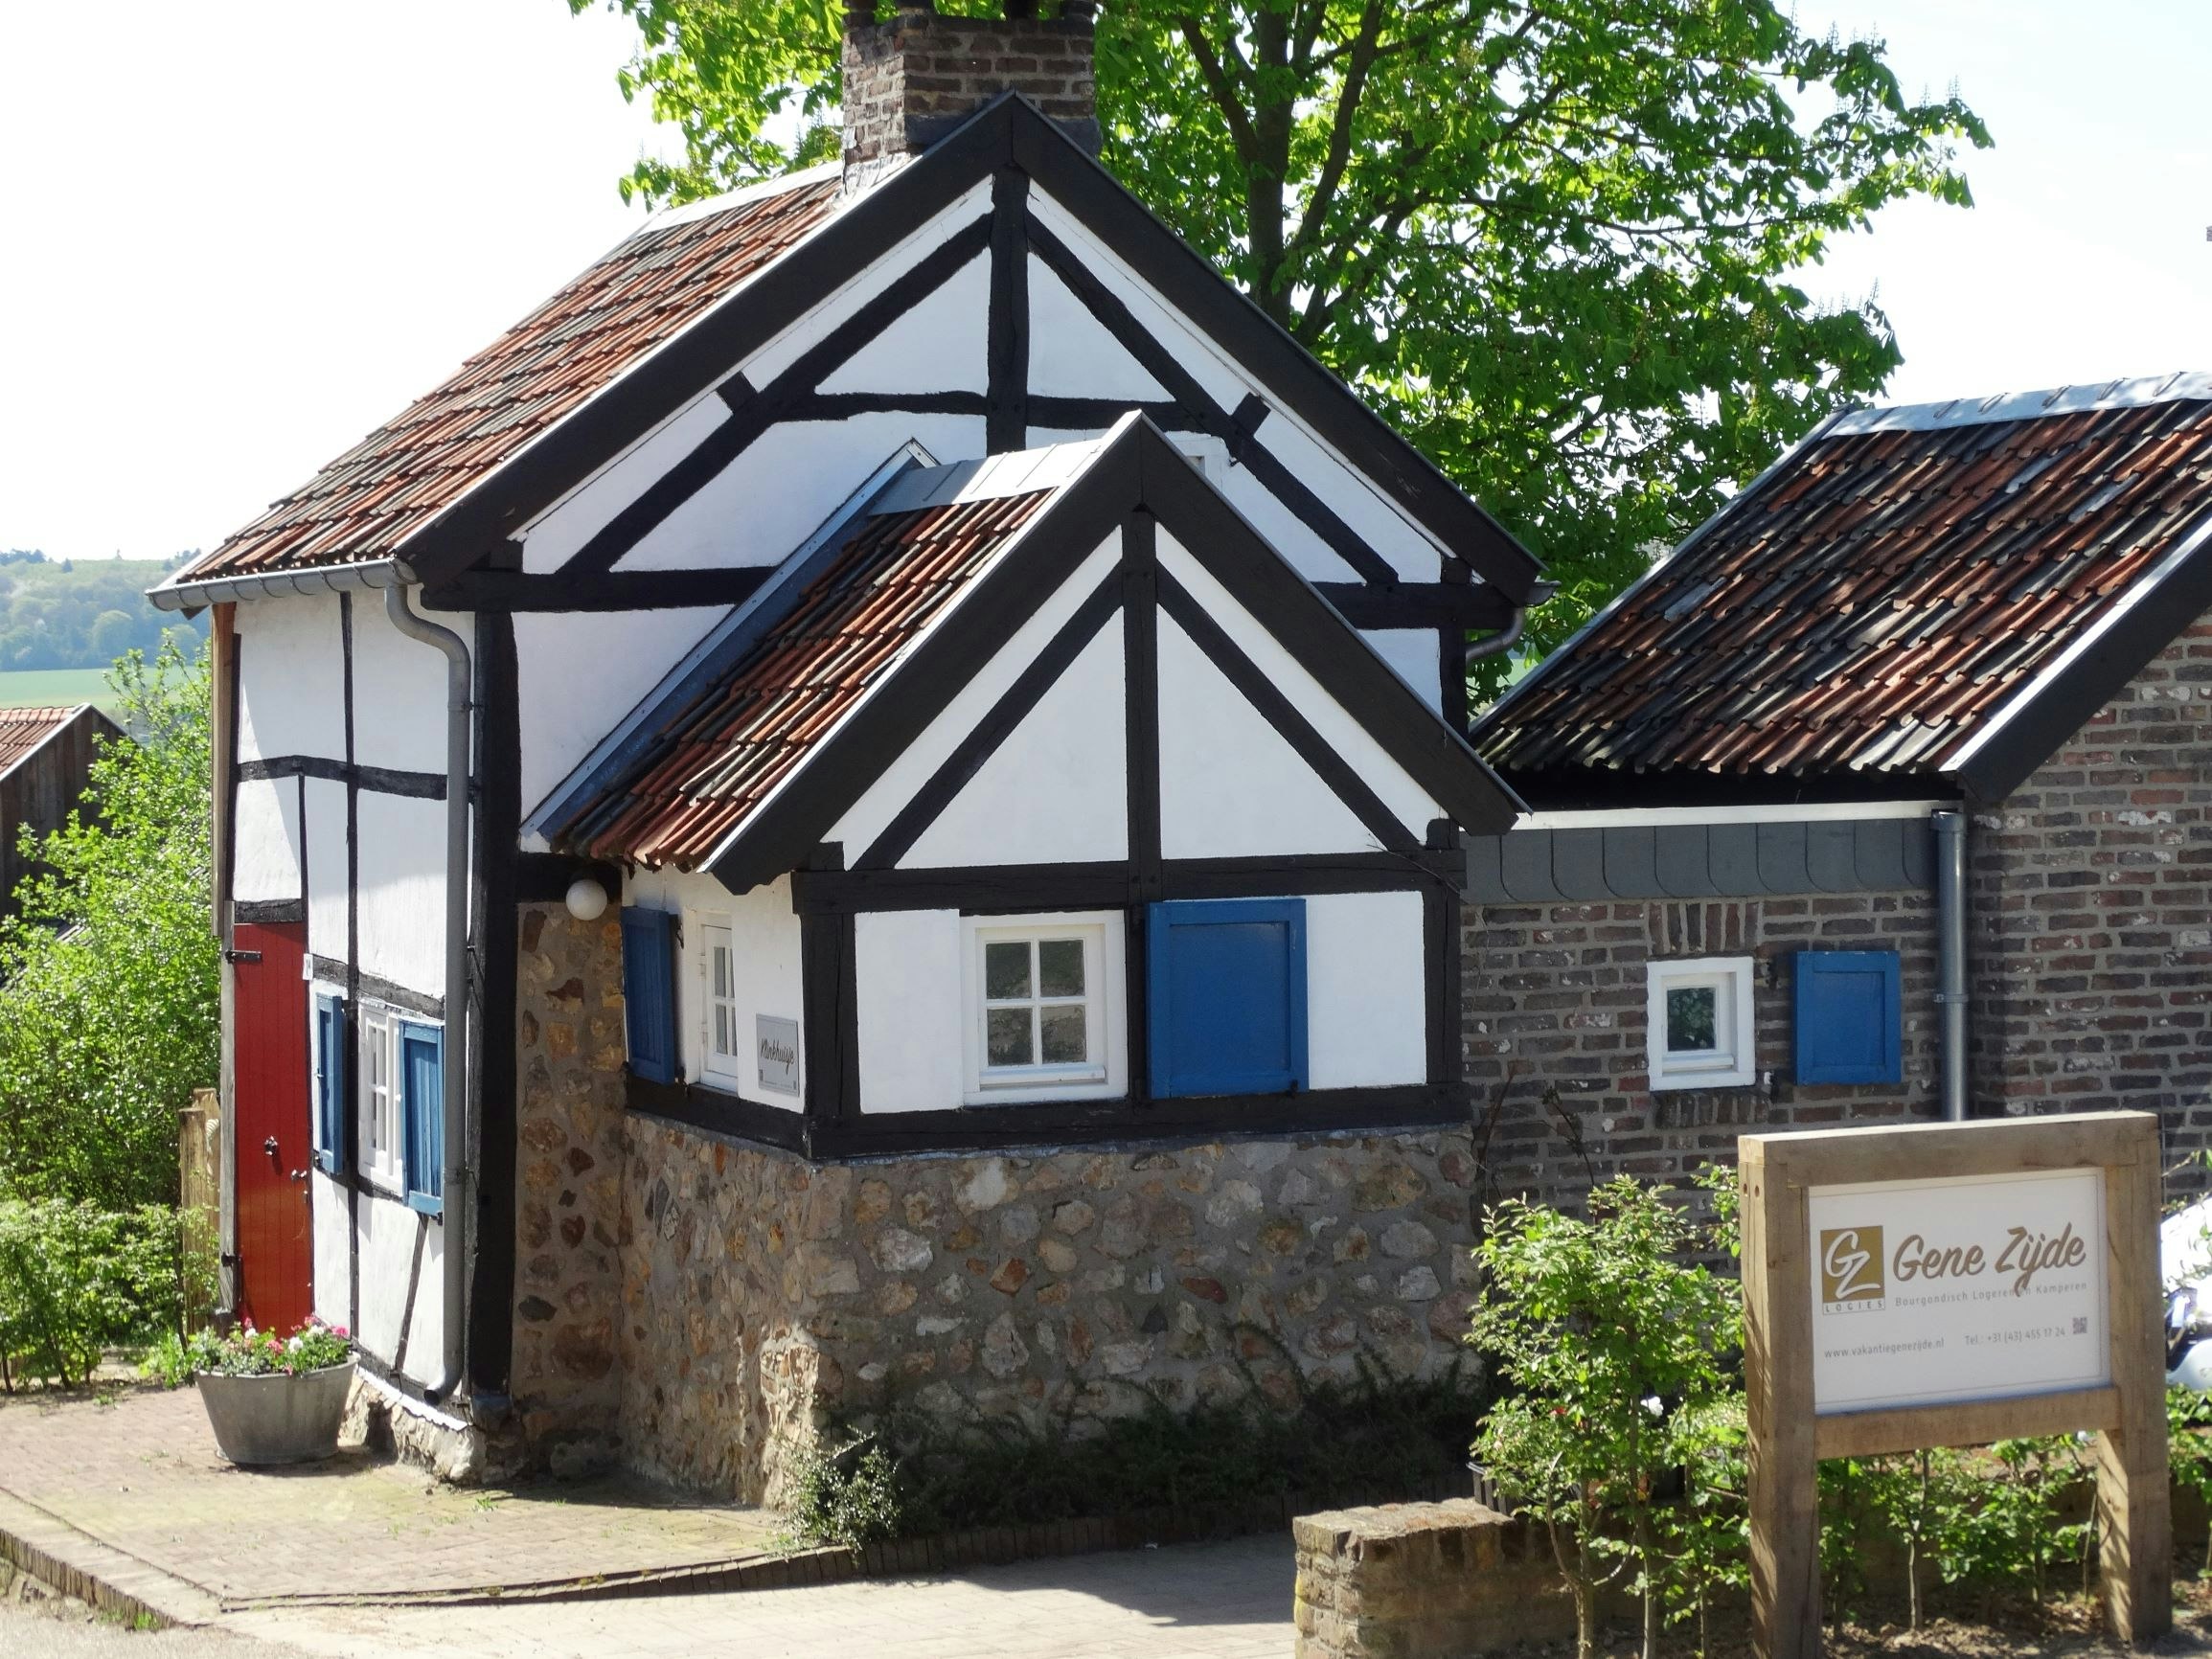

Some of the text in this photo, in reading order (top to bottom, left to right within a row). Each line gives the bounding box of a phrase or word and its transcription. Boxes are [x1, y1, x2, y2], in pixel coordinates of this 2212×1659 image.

[1892, 1221, 2087, 1298] Gene Zijde
[1895, 1291, 1968, 1307] Bourgondisch
[1973, 1287, 2015, 1303] Logeren
[2036, 1282, 2087, 1295] Kamperen
[1825, 1300, 1882, 1313] LOGIES
[1824, 1336, 1945, 1358] www.vakantiegenezijde.nl
[1988, 1332, 2001, 1344] +31
